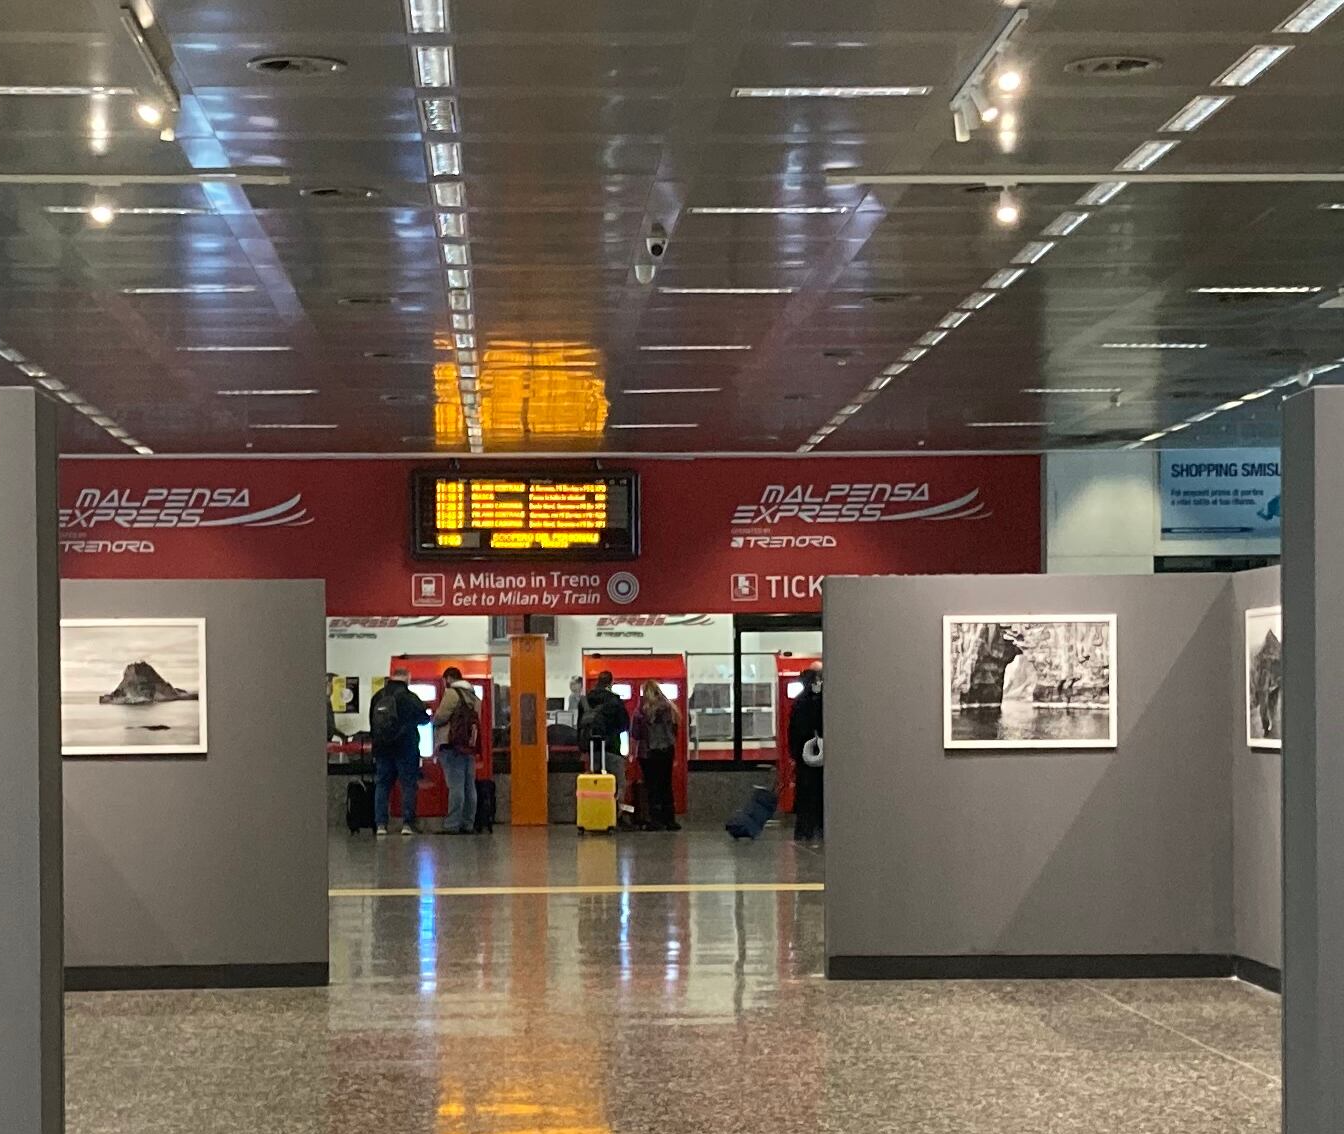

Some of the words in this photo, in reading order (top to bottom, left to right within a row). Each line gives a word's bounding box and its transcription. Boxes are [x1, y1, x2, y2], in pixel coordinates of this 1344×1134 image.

[1171, 463, 1238, 478] SHOPPING
[76, 488, 250, 508] MALPENSA
[760, 483, 929, 504] MALPENSA
[731, 504, 885, 524] EXPRESS
[59, 540, 155, 553] TRENORD
[745, 535, 837, 548] TRENORD
[453, 573, 466, 589] A
[470, 572, 527, 589] Milano
[531, 573, 546, 588] in
[550, 571, 600, 587] Treno
[452, 592, 477, 607] Get
[481, 593, 495, 606] to
[499, 591, 538, 606] Milan
[542, 590, 560, 608] by
[563, 589, 600, 604] Train
